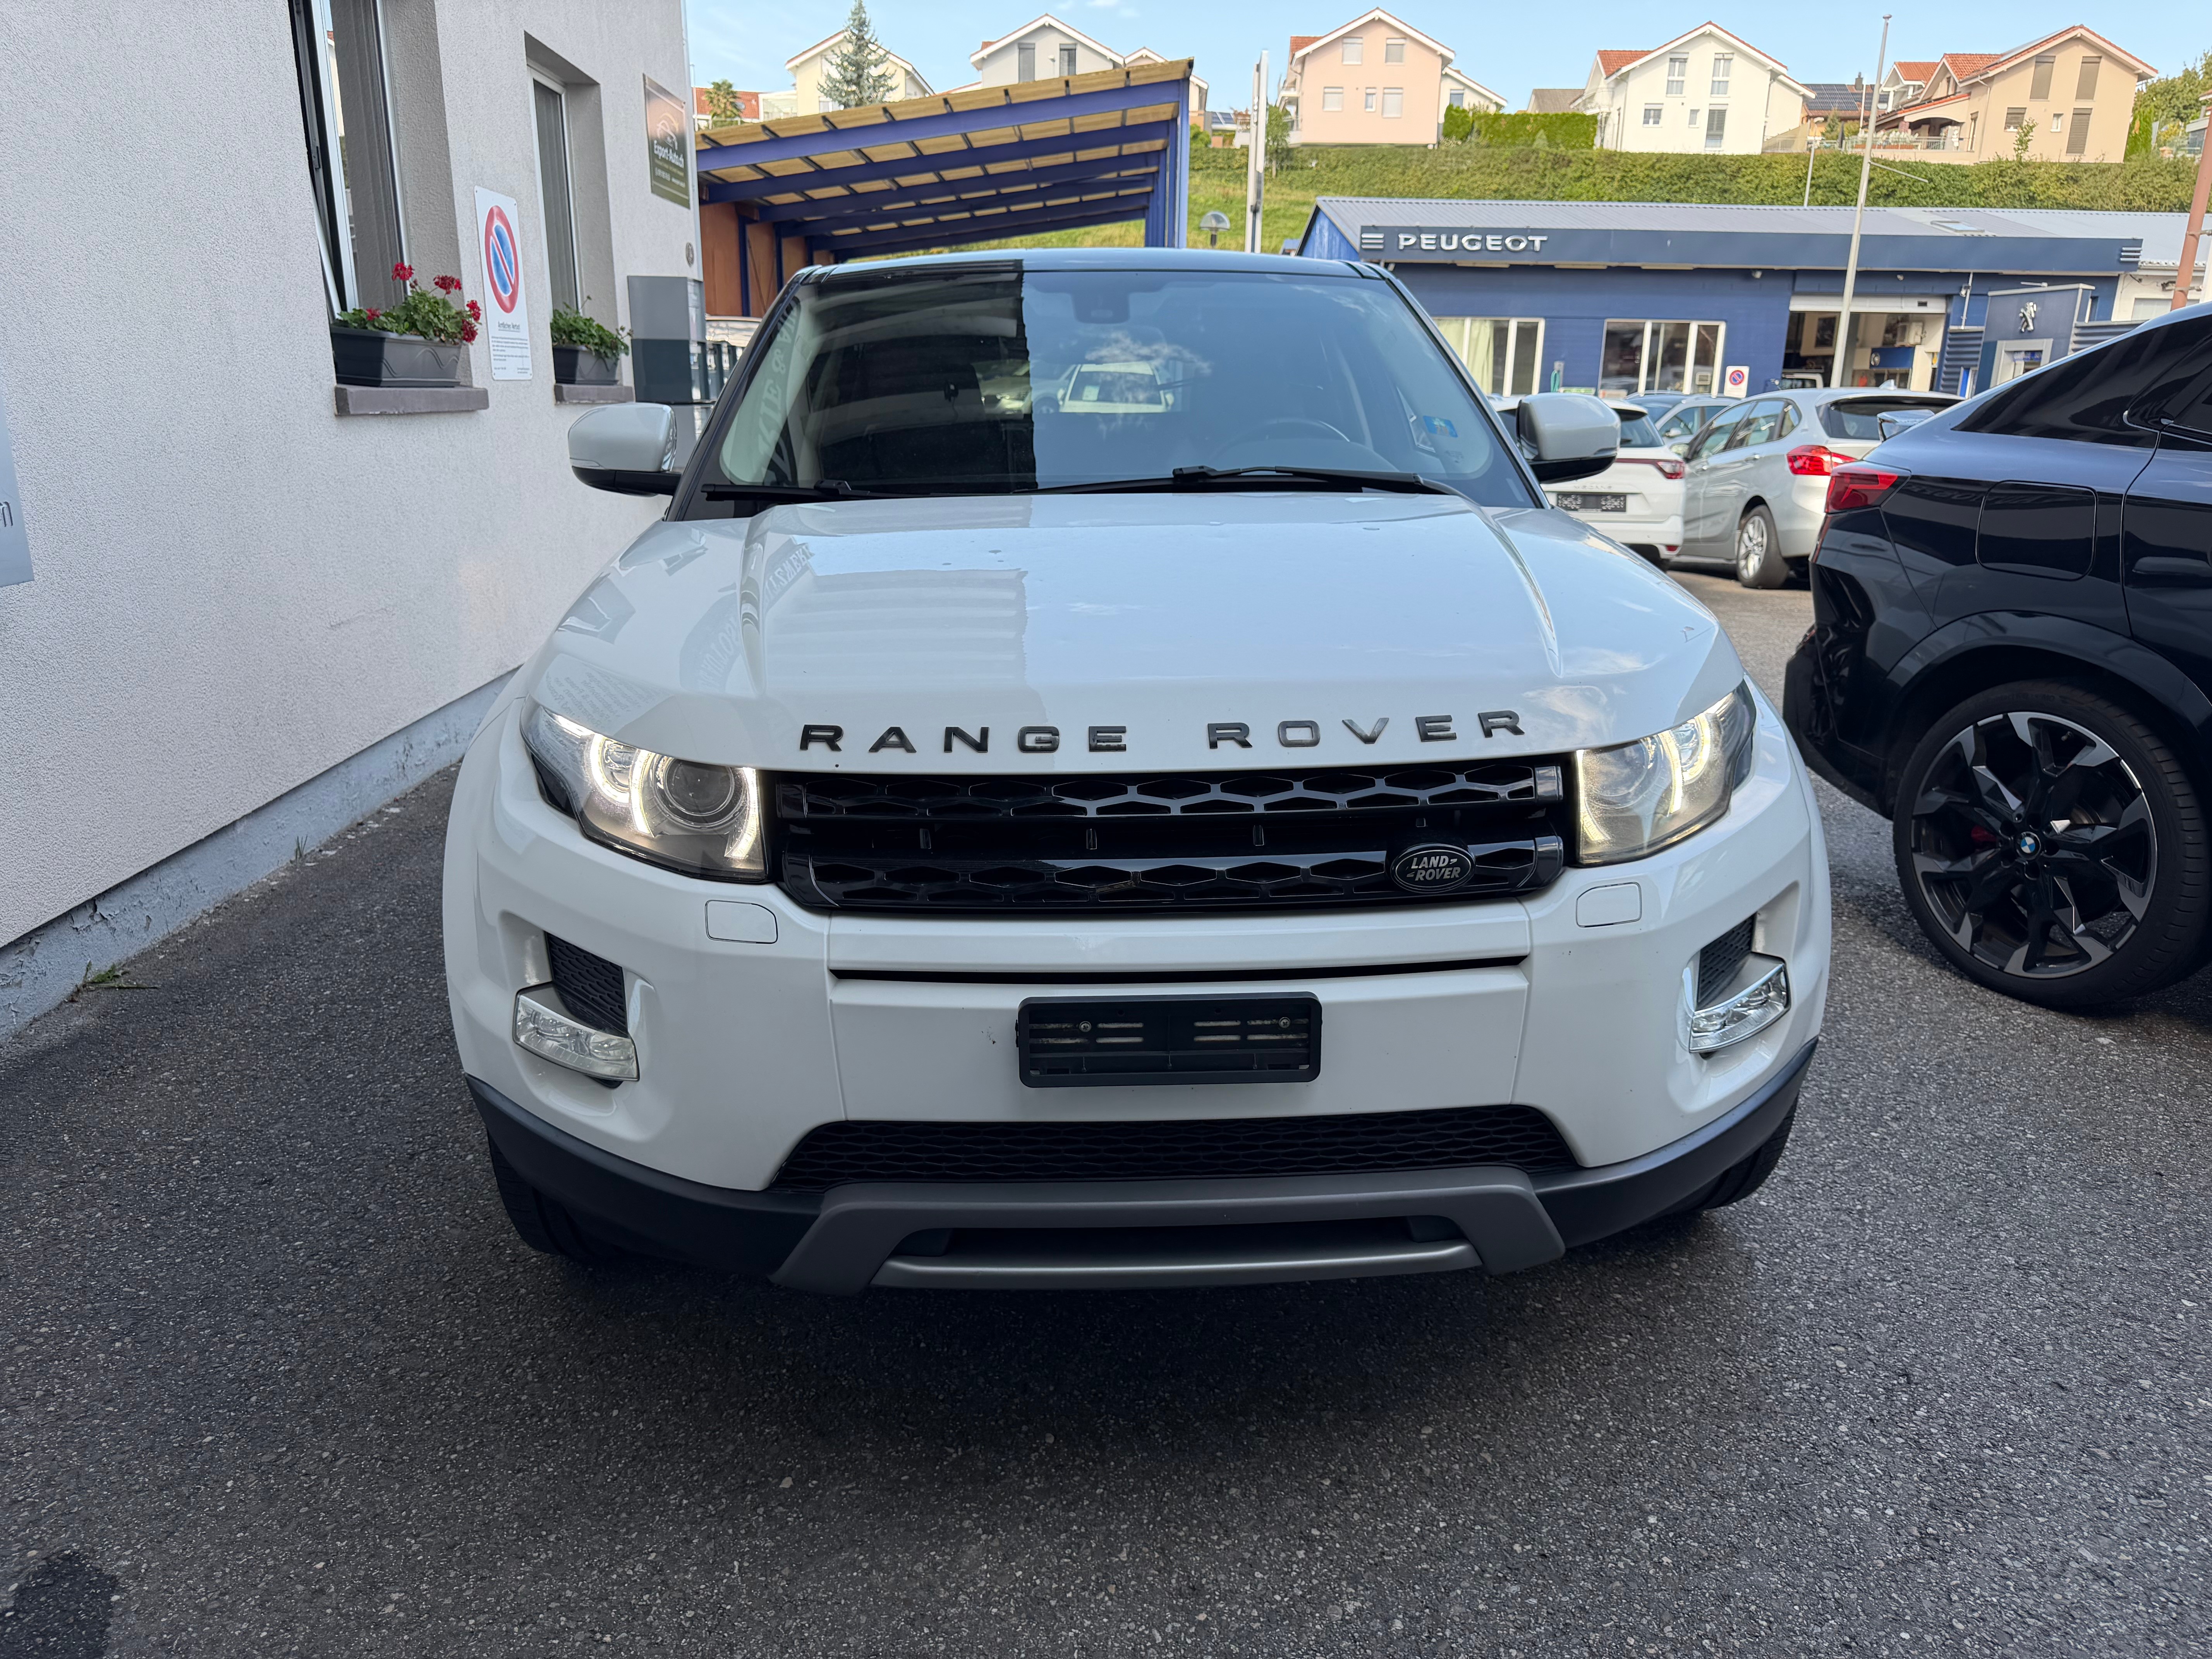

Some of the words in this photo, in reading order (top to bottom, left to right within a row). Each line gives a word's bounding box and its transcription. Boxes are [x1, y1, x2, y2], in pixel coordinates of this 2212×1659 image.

[1398, 234, 1548, 251] PEUGEOT
[799, 724, 1127, 753] RANGE
[1207, 710, 1525, 749] ROVER
[1411, 855, 1449, 869] LAND
[1415, 867, 1461, 881] ROVER
